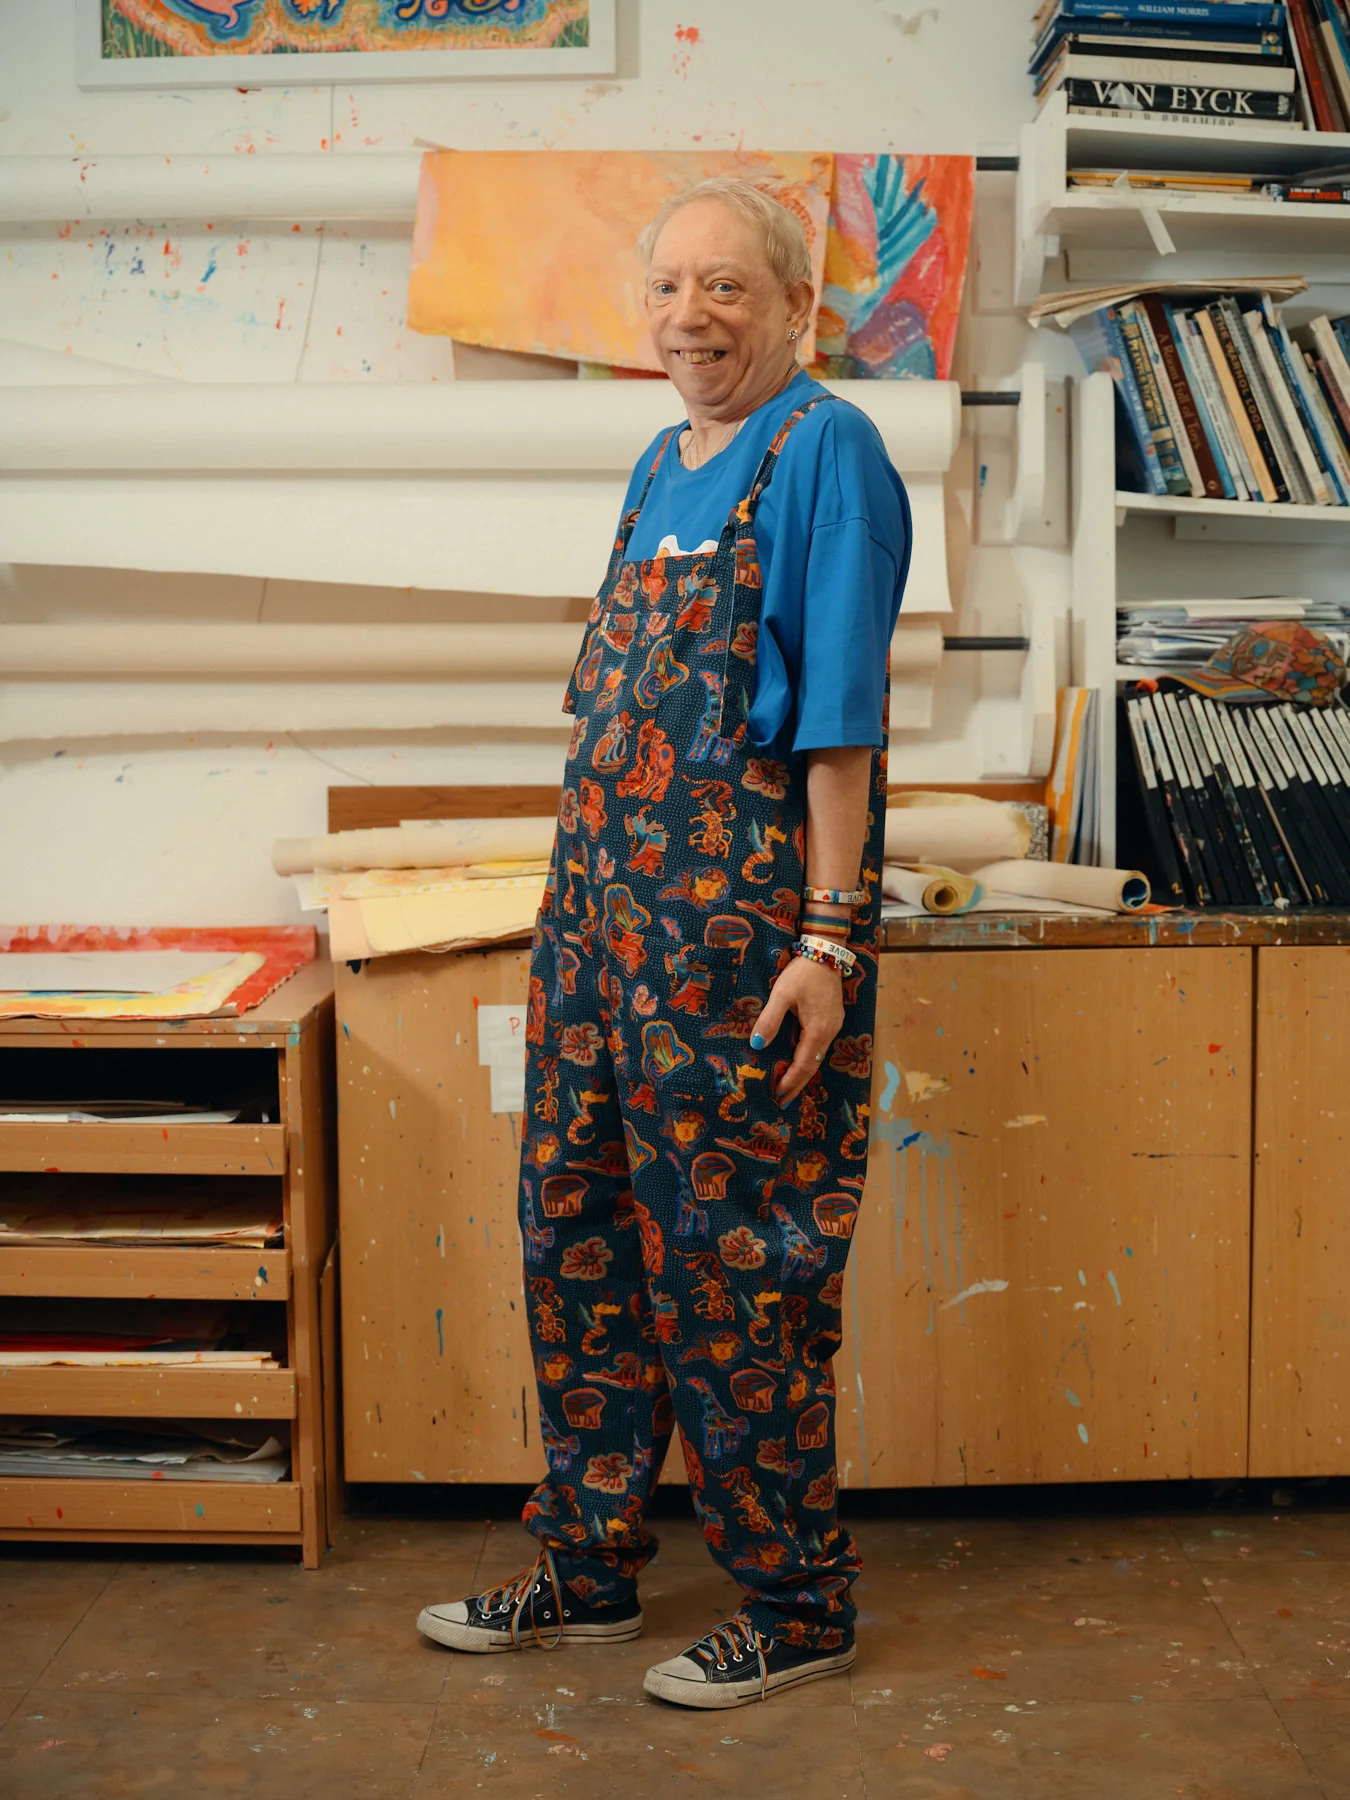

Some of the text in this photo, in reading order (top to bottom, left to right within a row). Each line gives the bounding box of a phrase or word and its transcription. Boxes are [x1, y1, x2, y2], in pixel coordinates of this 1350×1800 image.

[1138, 5, 1173, 16] WILLIAM
[1175, 6, 1209, 17] MORRIS
[1092, 80, 1155, 108] VAN
[1169, 86, 1254, 115] EYCK
[1158, 333, 1170, 344] A
[1163, 344, 1180, 380] Room
[1216, 314, 1265, 433] THE WARHOL LOOK
[1174, 380, 1190, 404] Full
[1182, 405, 1196, 419] of
[1187, 421, 1202, 450] Toys
